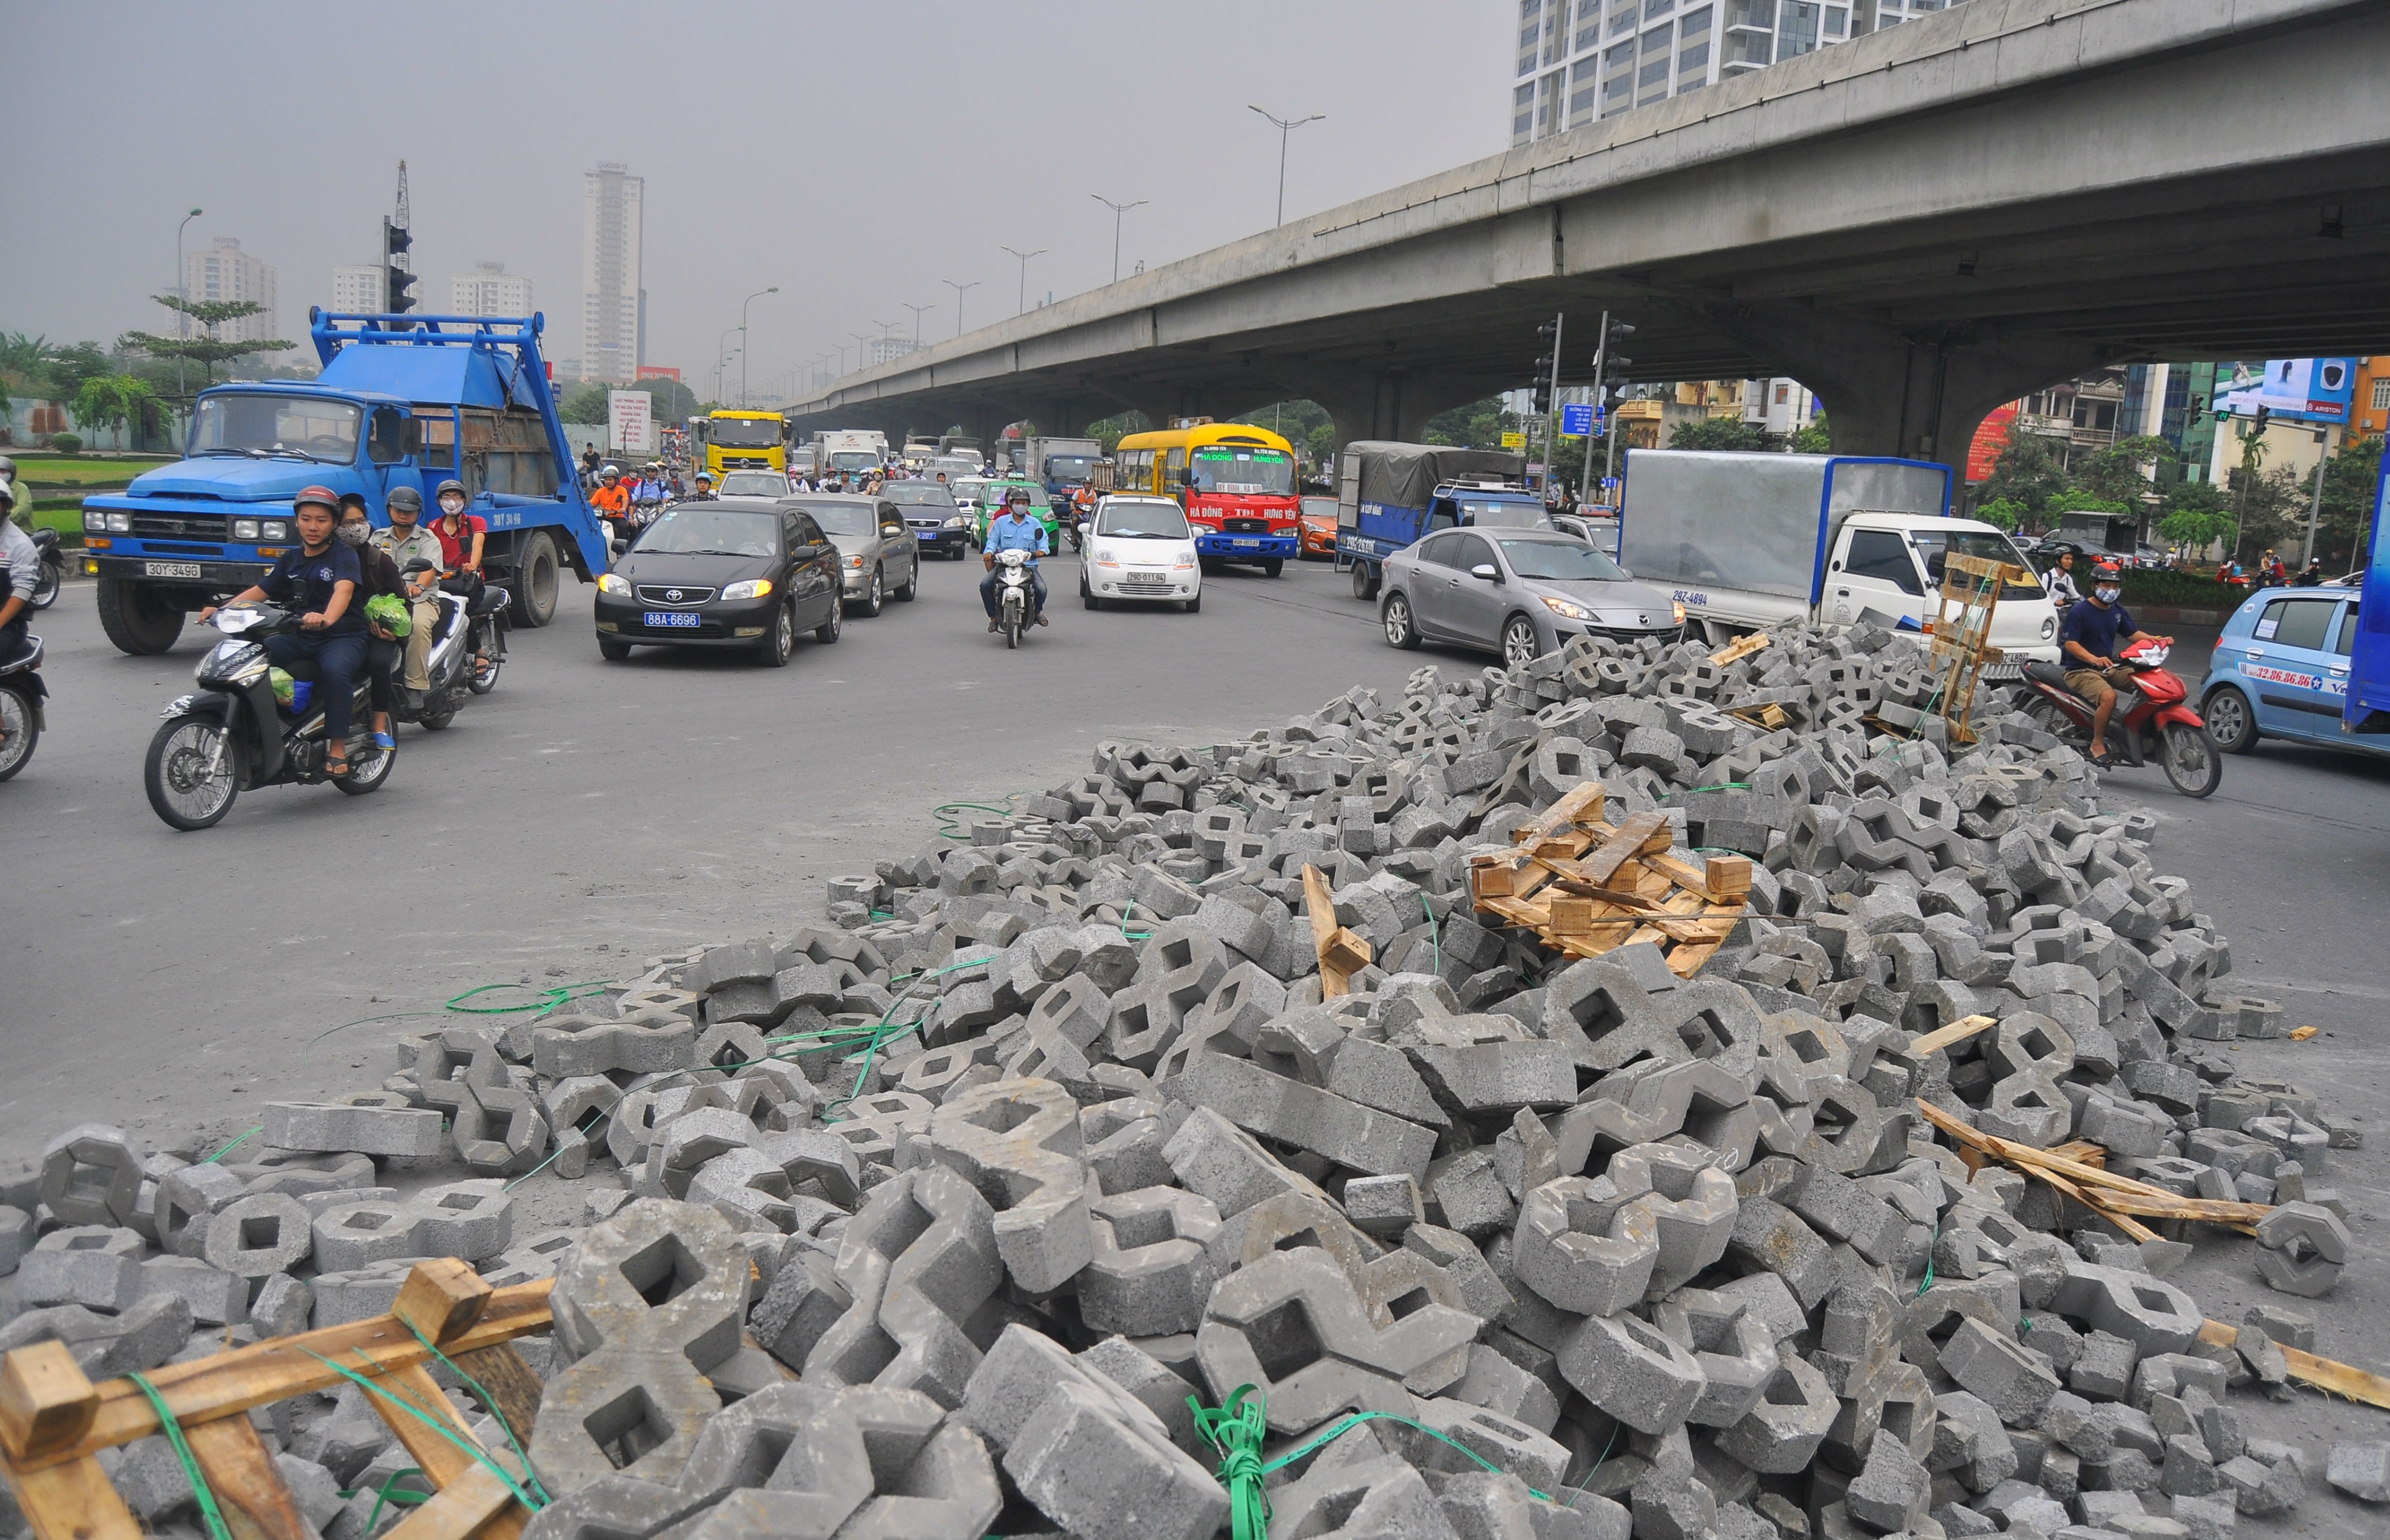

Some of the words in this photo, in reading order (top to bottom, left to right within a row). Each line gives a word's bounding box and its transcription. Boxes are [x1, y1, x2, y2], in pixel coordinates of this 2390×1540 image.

[2314, 406, 2341, 414] ARISTON
[1190, 505, 1200, 517] HÀ
[1202, 506, 1223, 517] ĐÔNG
[1264, 508, 1282, 519] HƯNG
[1284, 508, 1296, 521] YÊN
[149, 564, 198, 576] 30Y-3496
[1673, 590, 1708, 606] 29Z-4894
[648, 614, 696, 625] 88A-6696
